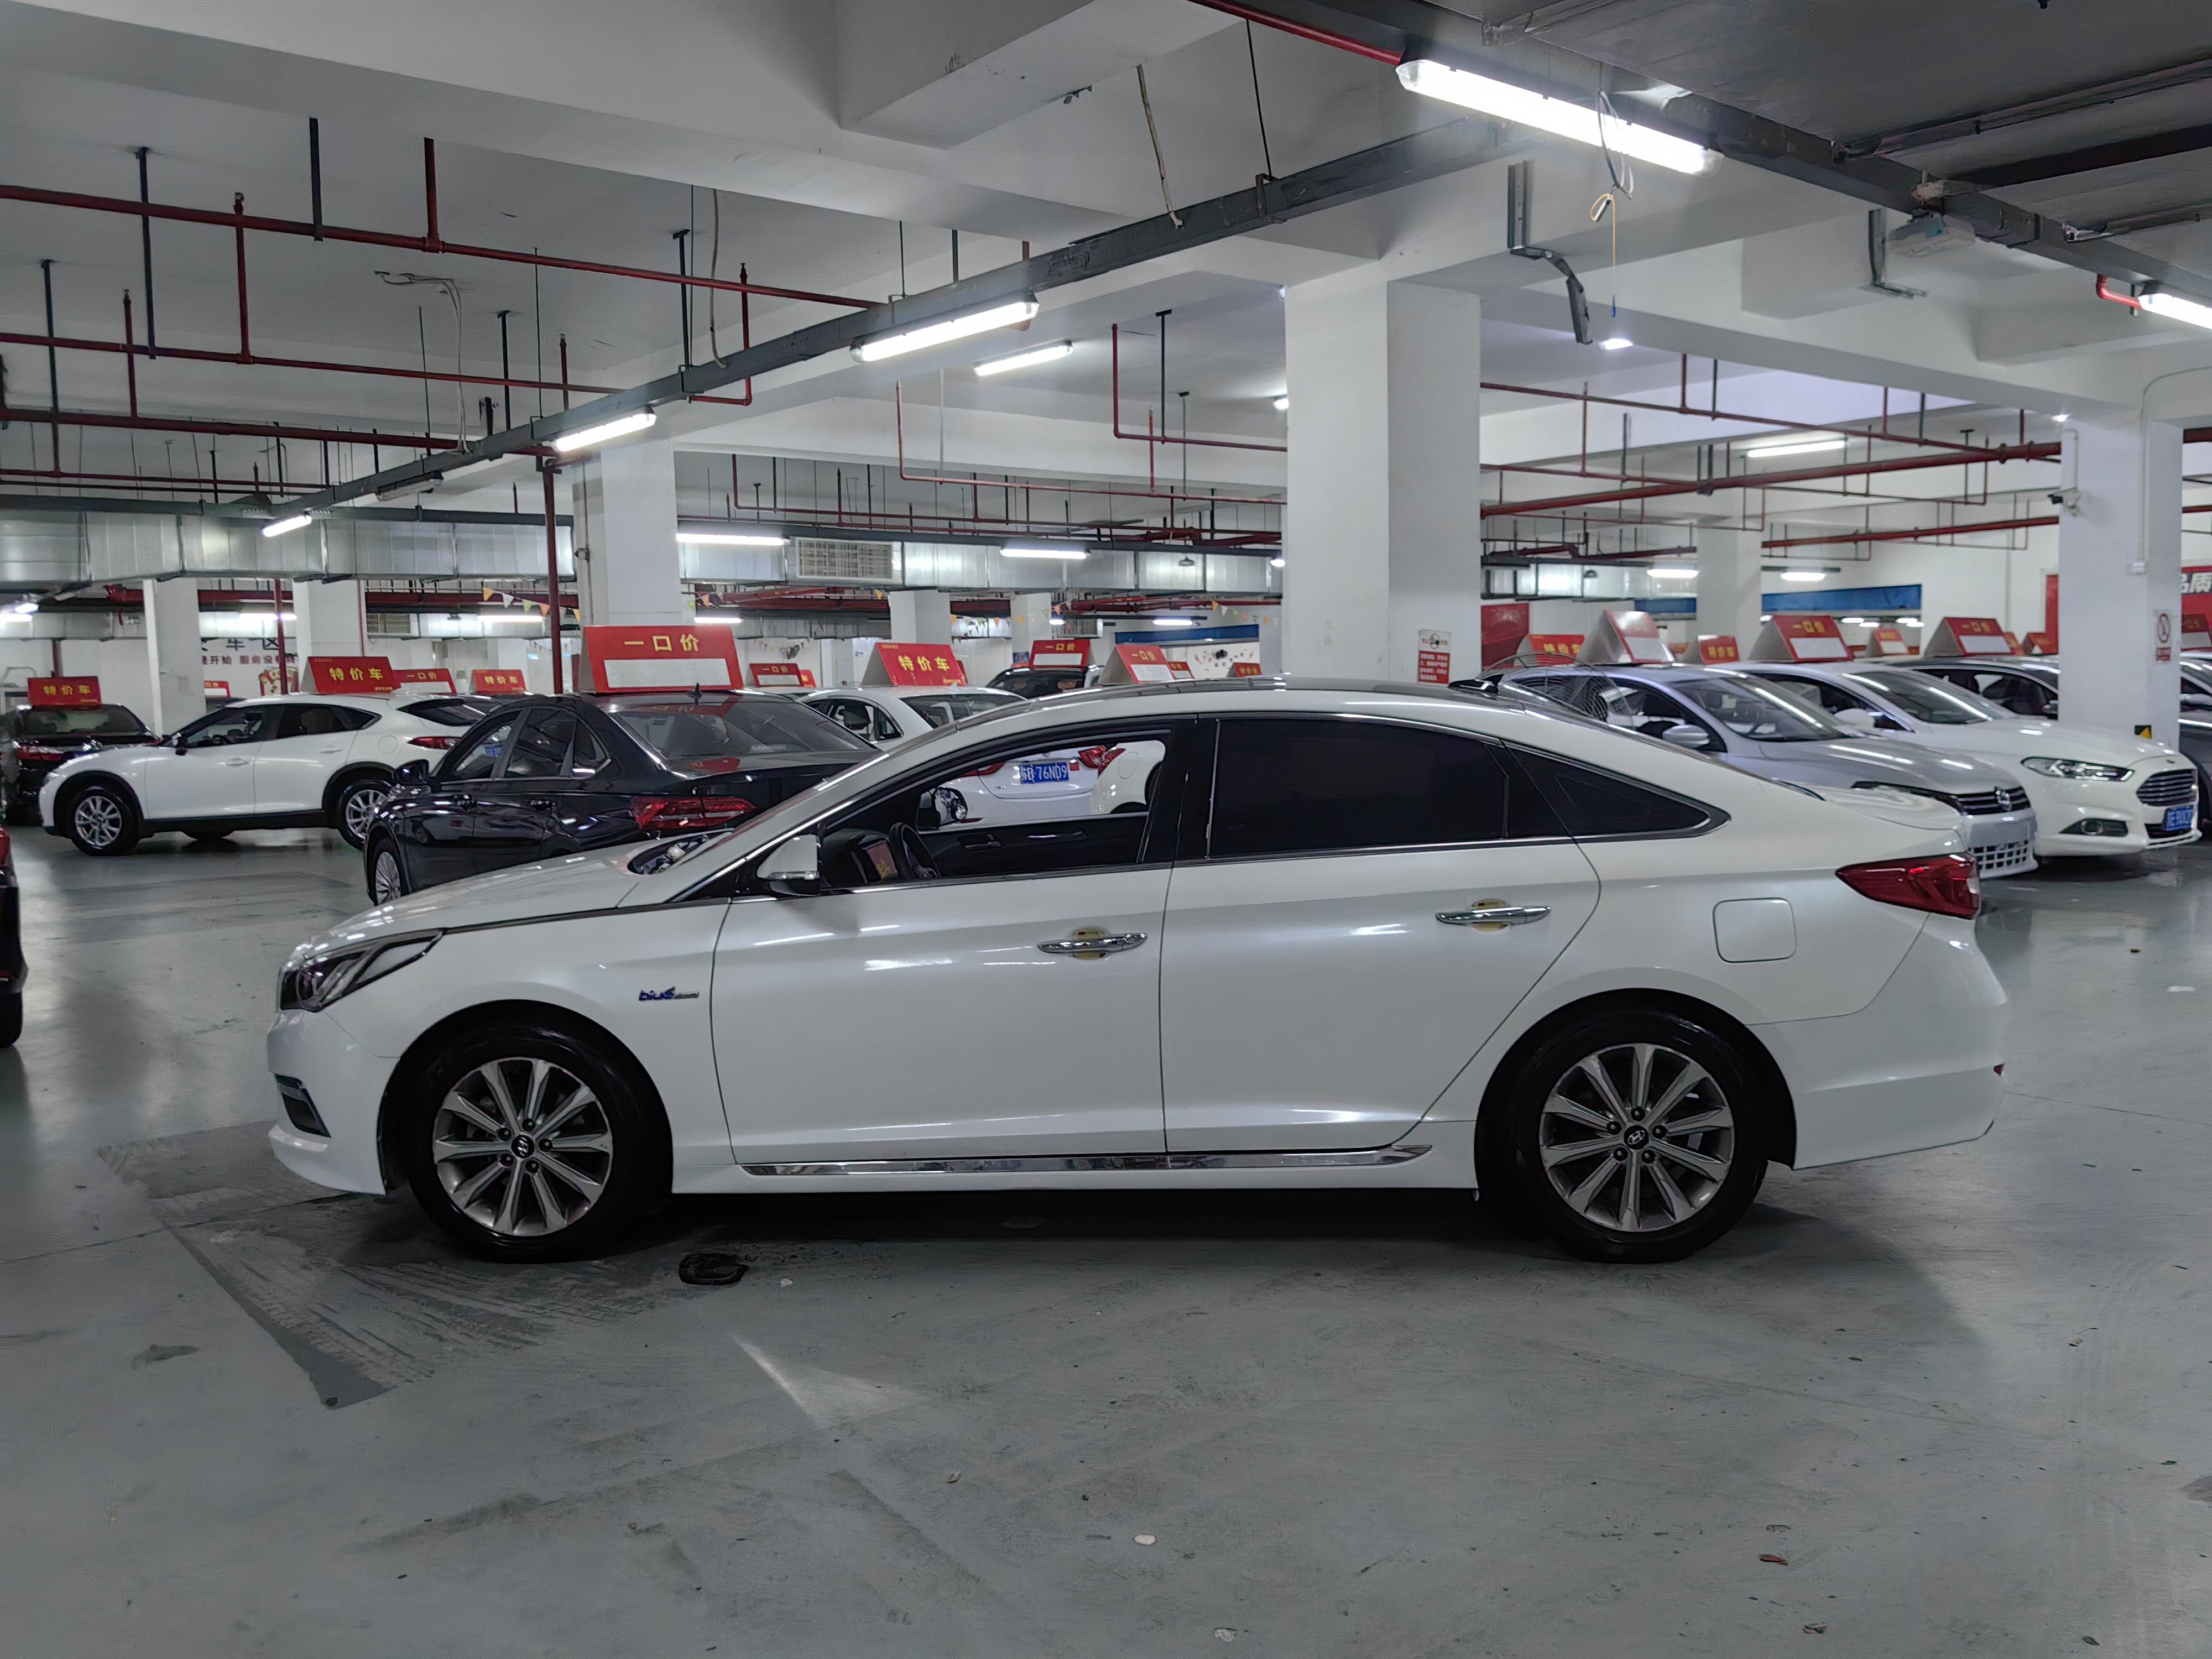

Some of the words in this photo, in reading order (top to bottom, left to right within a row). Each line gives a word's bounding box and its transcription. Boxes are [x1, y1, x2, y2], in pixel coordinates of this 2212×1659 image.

[624, 633, 699, 652] 一口价
[898, 655, 951, 671] 特价车
[328, 667, 384, 681] 特价车
[43, 685, 91, 695] 特价车
